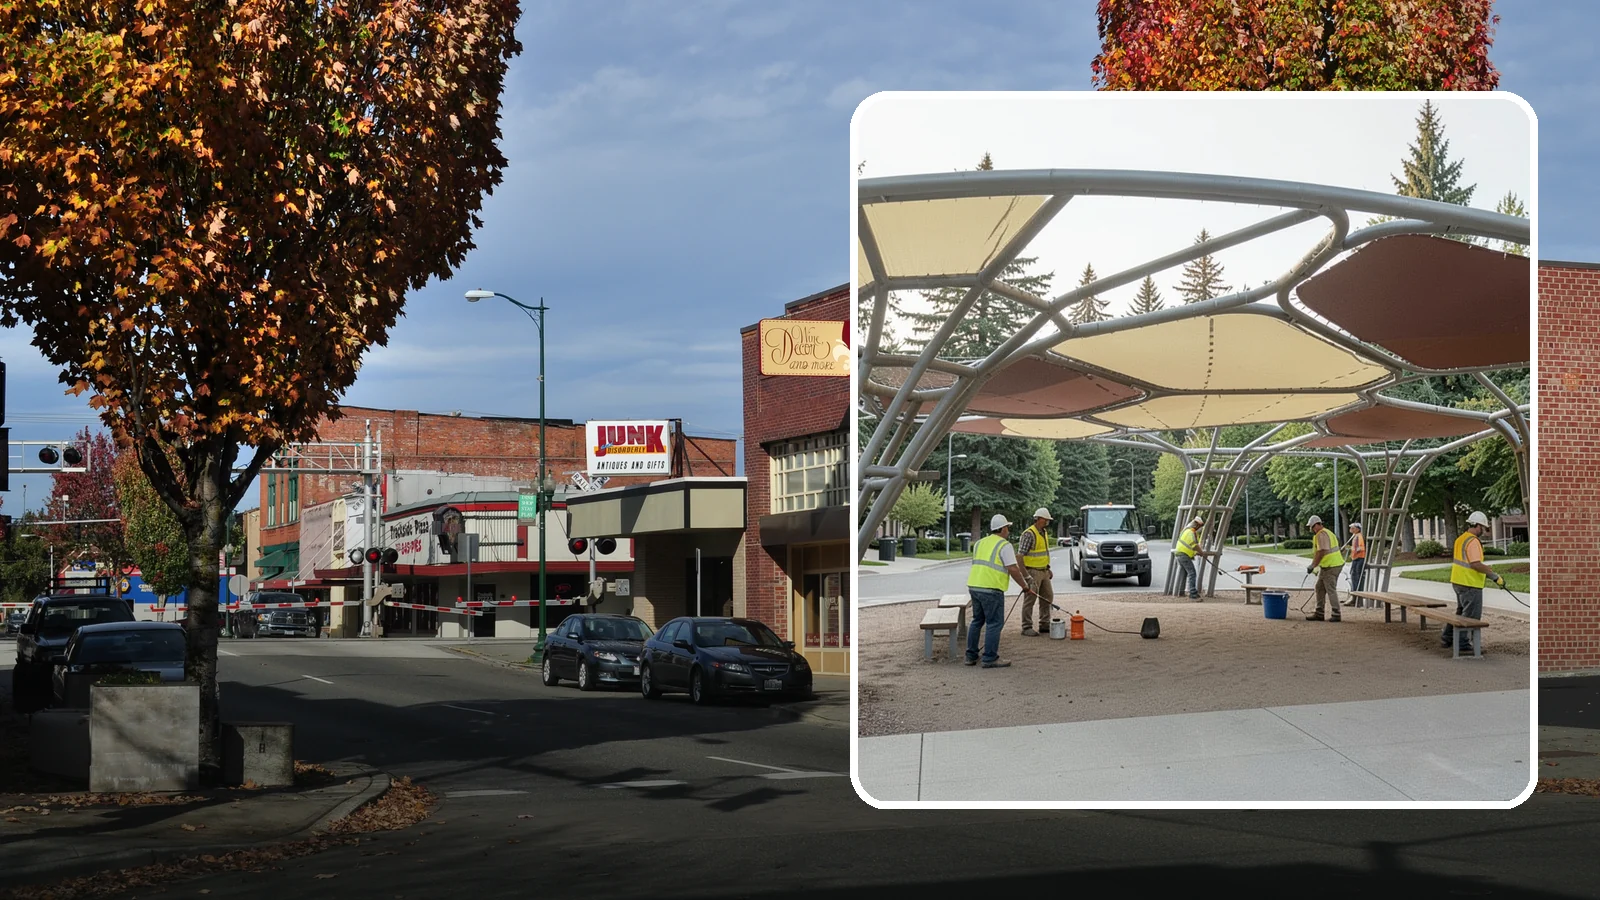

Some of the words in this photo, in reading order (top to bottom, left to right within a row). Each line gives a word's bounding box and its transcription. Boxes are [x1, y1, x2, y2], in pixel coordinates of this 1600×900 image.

[595, 425, 666, 457] JUNK
[607, 446, 645, 454] DISORDERLY
[597, 461, 628, 470] ANTIQUES
[631, 461, 643, 470] AND
[647, 460, 665, 470] GIFTS
[390, 524, 413, 540] Trackside
[414, 519, 429, 534] Pizza
